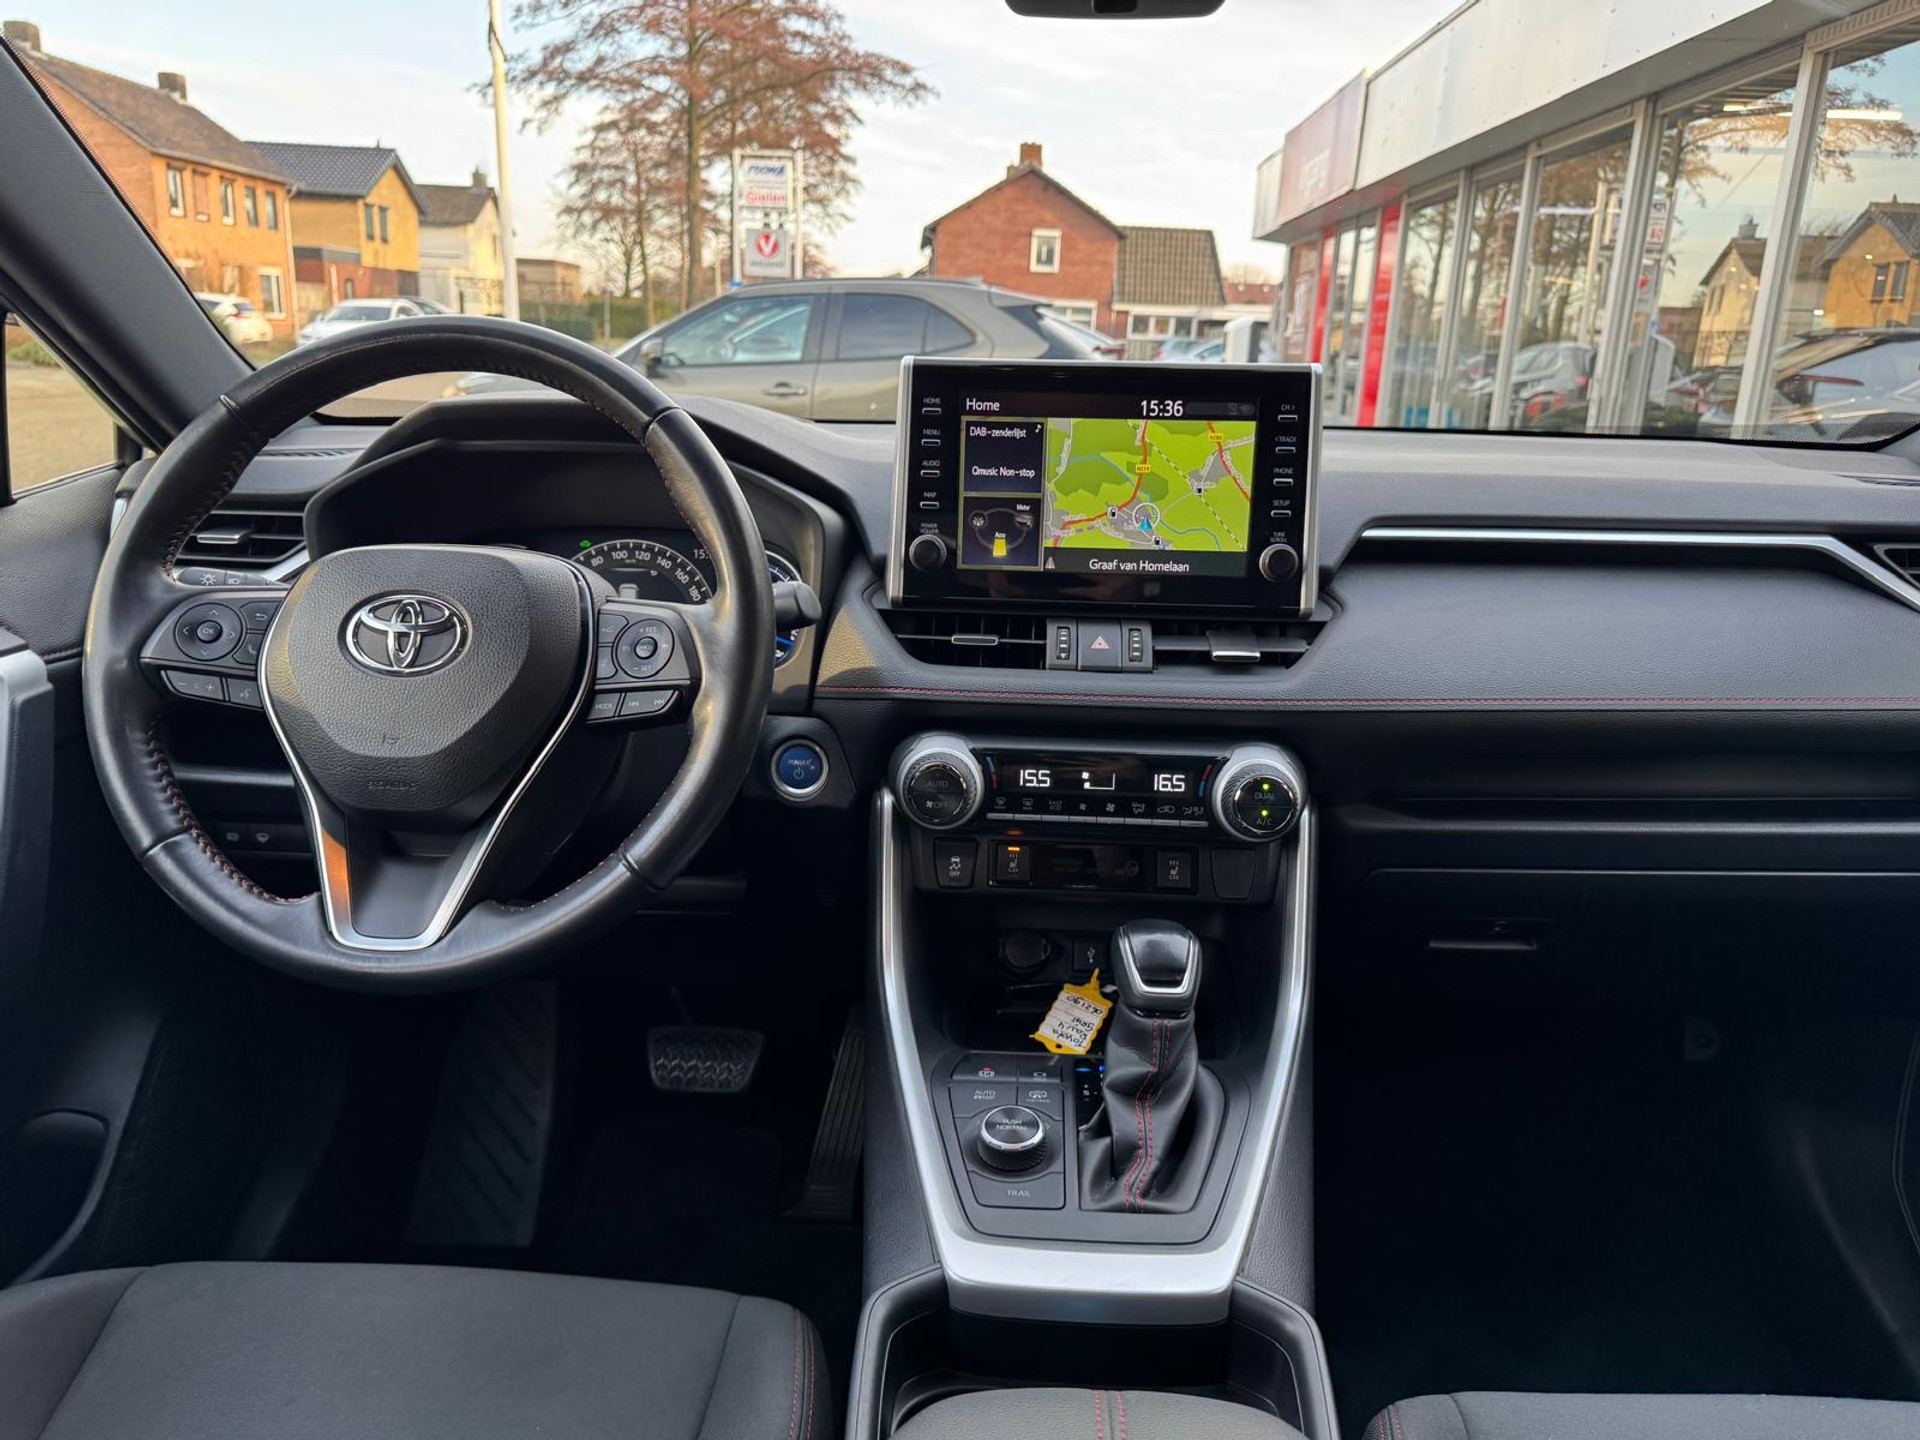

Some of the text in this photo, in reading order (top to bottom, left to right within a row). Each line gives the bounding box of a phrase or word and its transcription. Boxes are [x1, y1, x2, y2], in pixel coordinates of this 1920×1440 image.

[965, 397, 1000, 411] Home
[1140, 399, 1183, 417] 15:36
[922, 428, 941, 436] MENU
[969, 426, 1027, 440] DAB-zenderlijst
[971, 465, 1036, 479] Qmusic Non-stop
[1272, 499, 1291, 507] SETUP
[611, 550, 628, 560] 100
[635, 550, 651, 561] 120
[590, 556, 604, 568] 80
[656, 555, 672, 570] 140
[1089, 558, 1118, 570] Graaf
[1119, 561, 1137, 571] van
[674, 567, 689, 584] 160
[688, 585, 701, 602] 180
[202, 626, 215, 635] OK
[926, 780, 949, 788] AUTO
[1007, 1189, 1030, 1197] TRAIL
